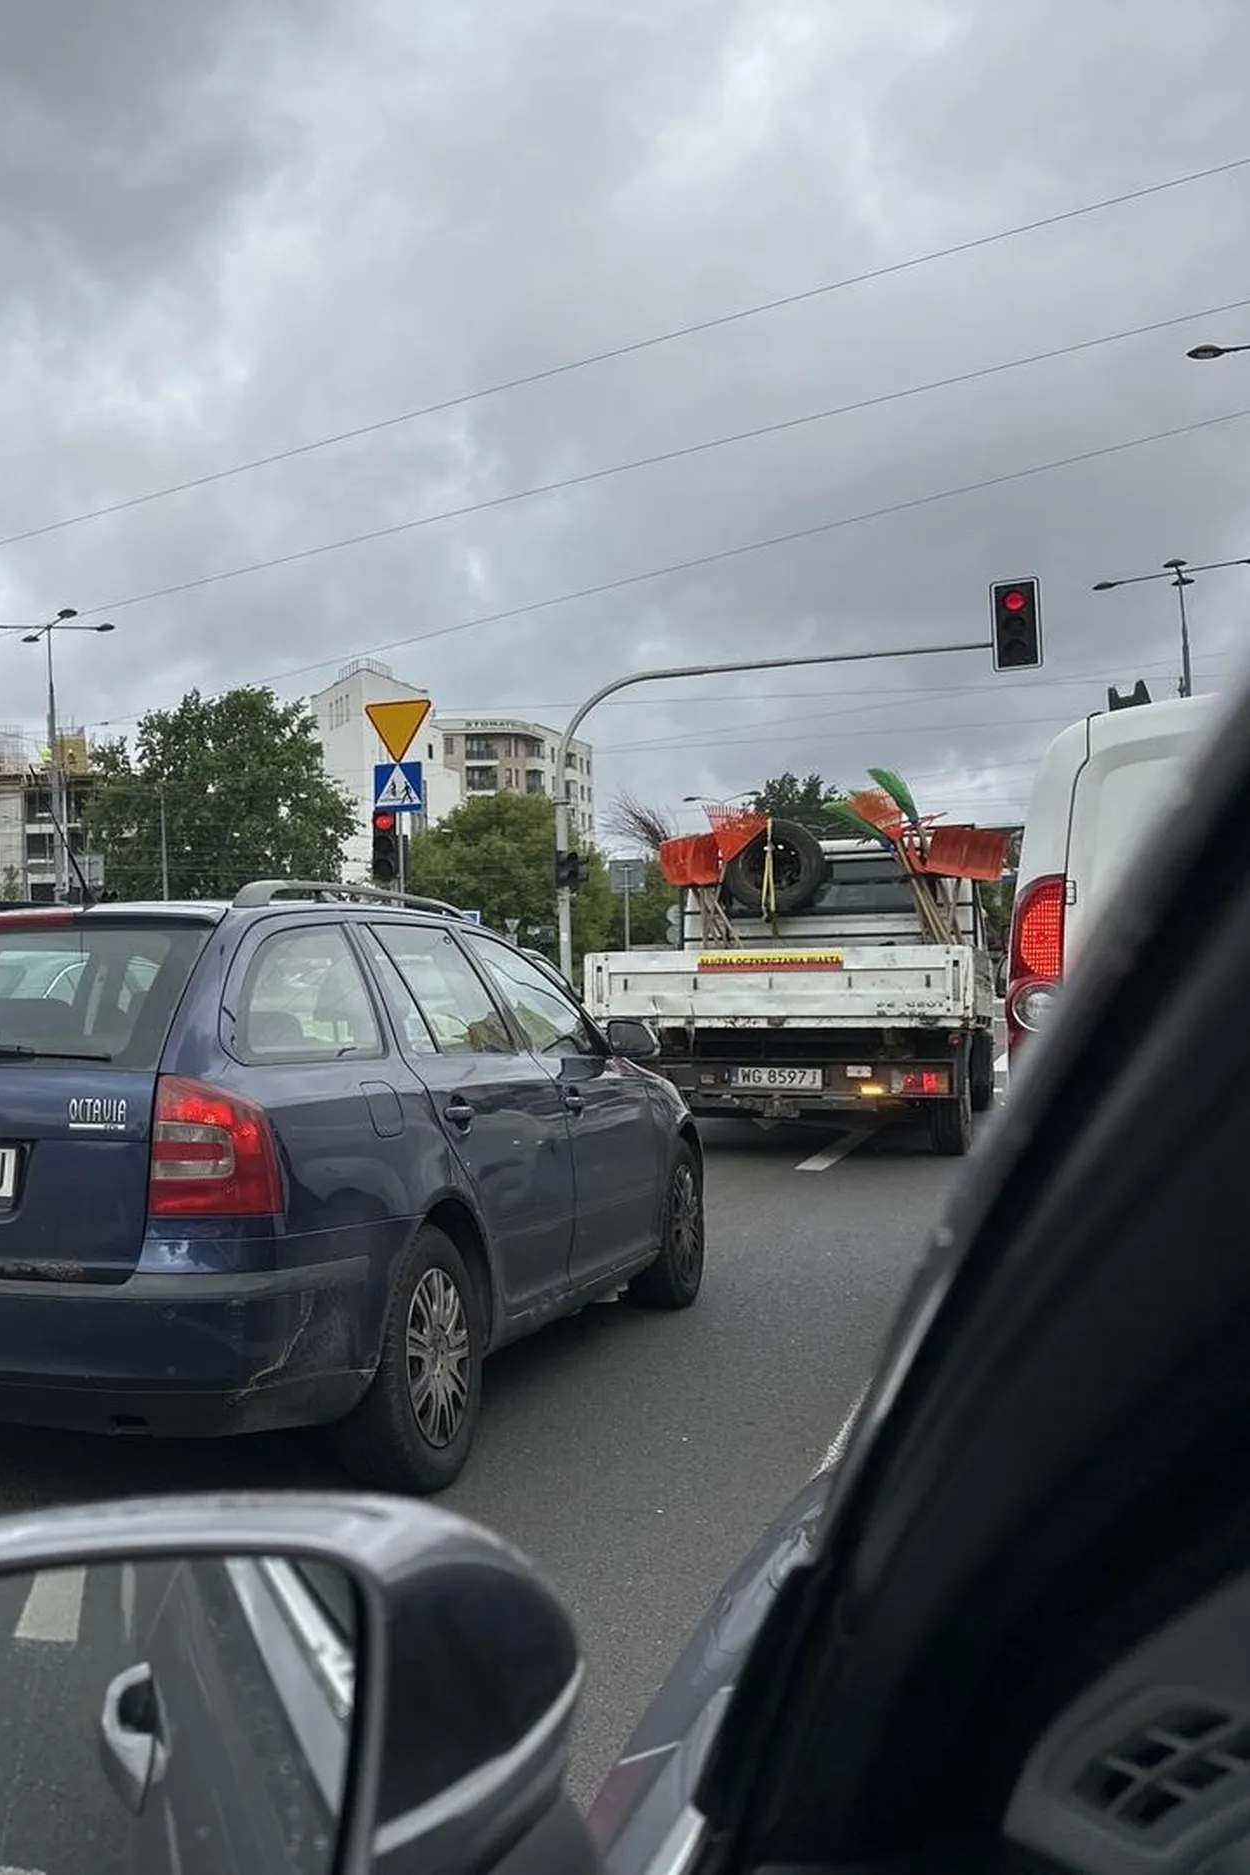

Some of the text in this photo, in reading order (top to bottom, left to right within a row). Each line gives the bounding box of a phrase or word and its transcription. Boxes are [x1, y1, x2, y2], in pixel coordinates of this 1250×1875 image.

[741, 1069, 817, 1085] WG 8597J
[69, 1098, 126, 1122] OCTAVIA
